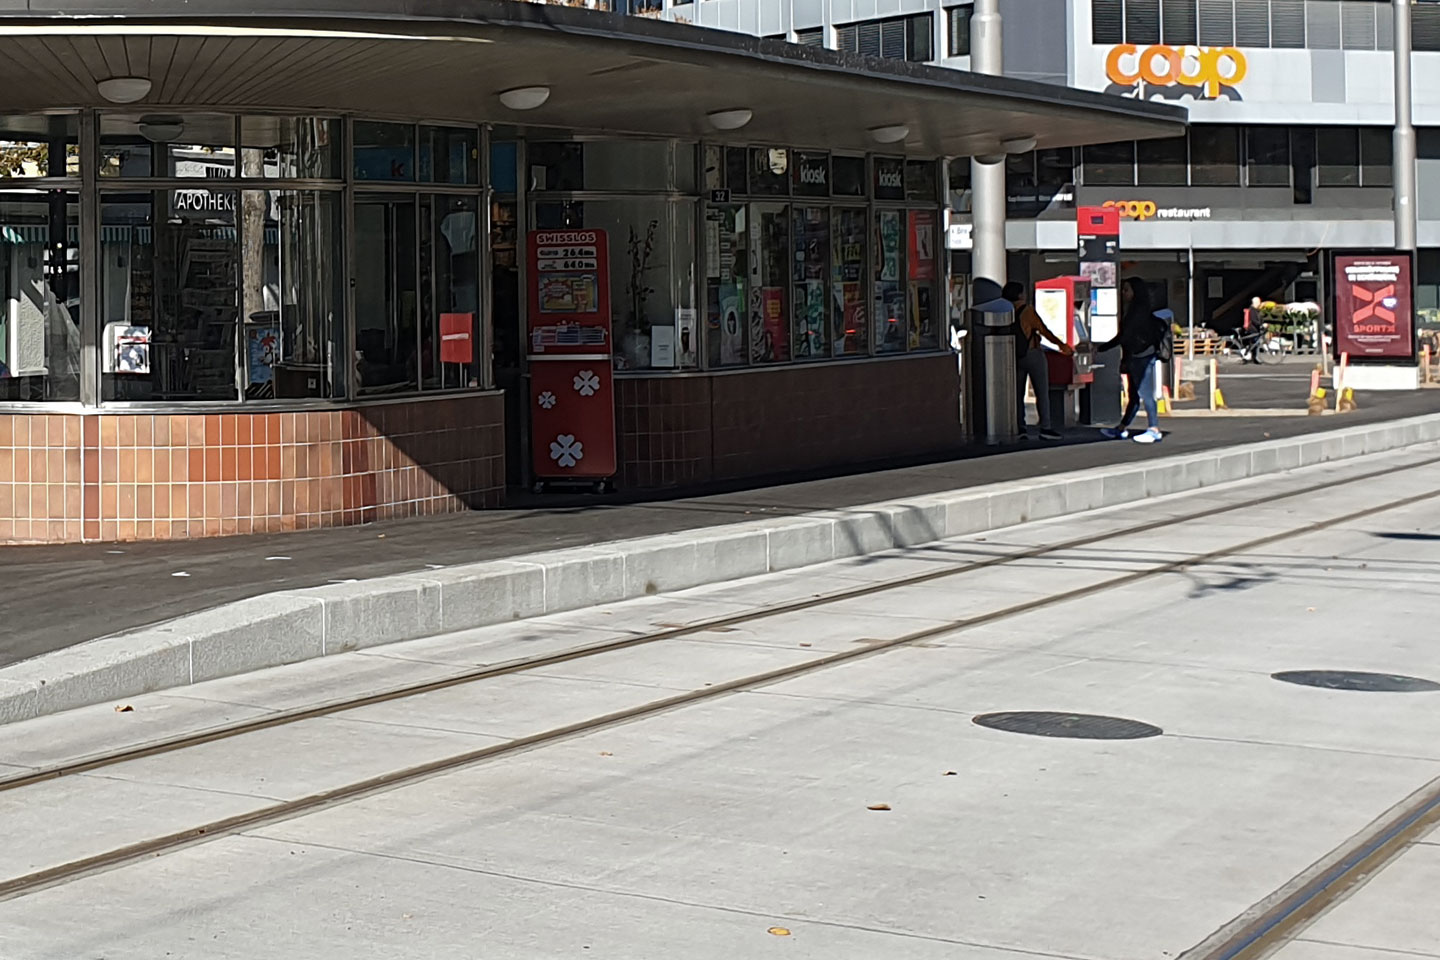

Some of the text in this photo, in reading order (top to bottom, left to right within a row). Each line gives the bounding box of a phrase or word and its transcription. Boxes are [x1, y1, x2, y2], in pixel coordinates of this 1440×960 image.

[1105, 43, 1248, 98] coop
[799, 164, 826, 185] kiosk
[878, 168, 902, 188] kiosk
[715, 191, 725, 201] 32
[1157, 207, 1211, 218] restaurant
[536, 231, 597, 244] SWISSLOS
